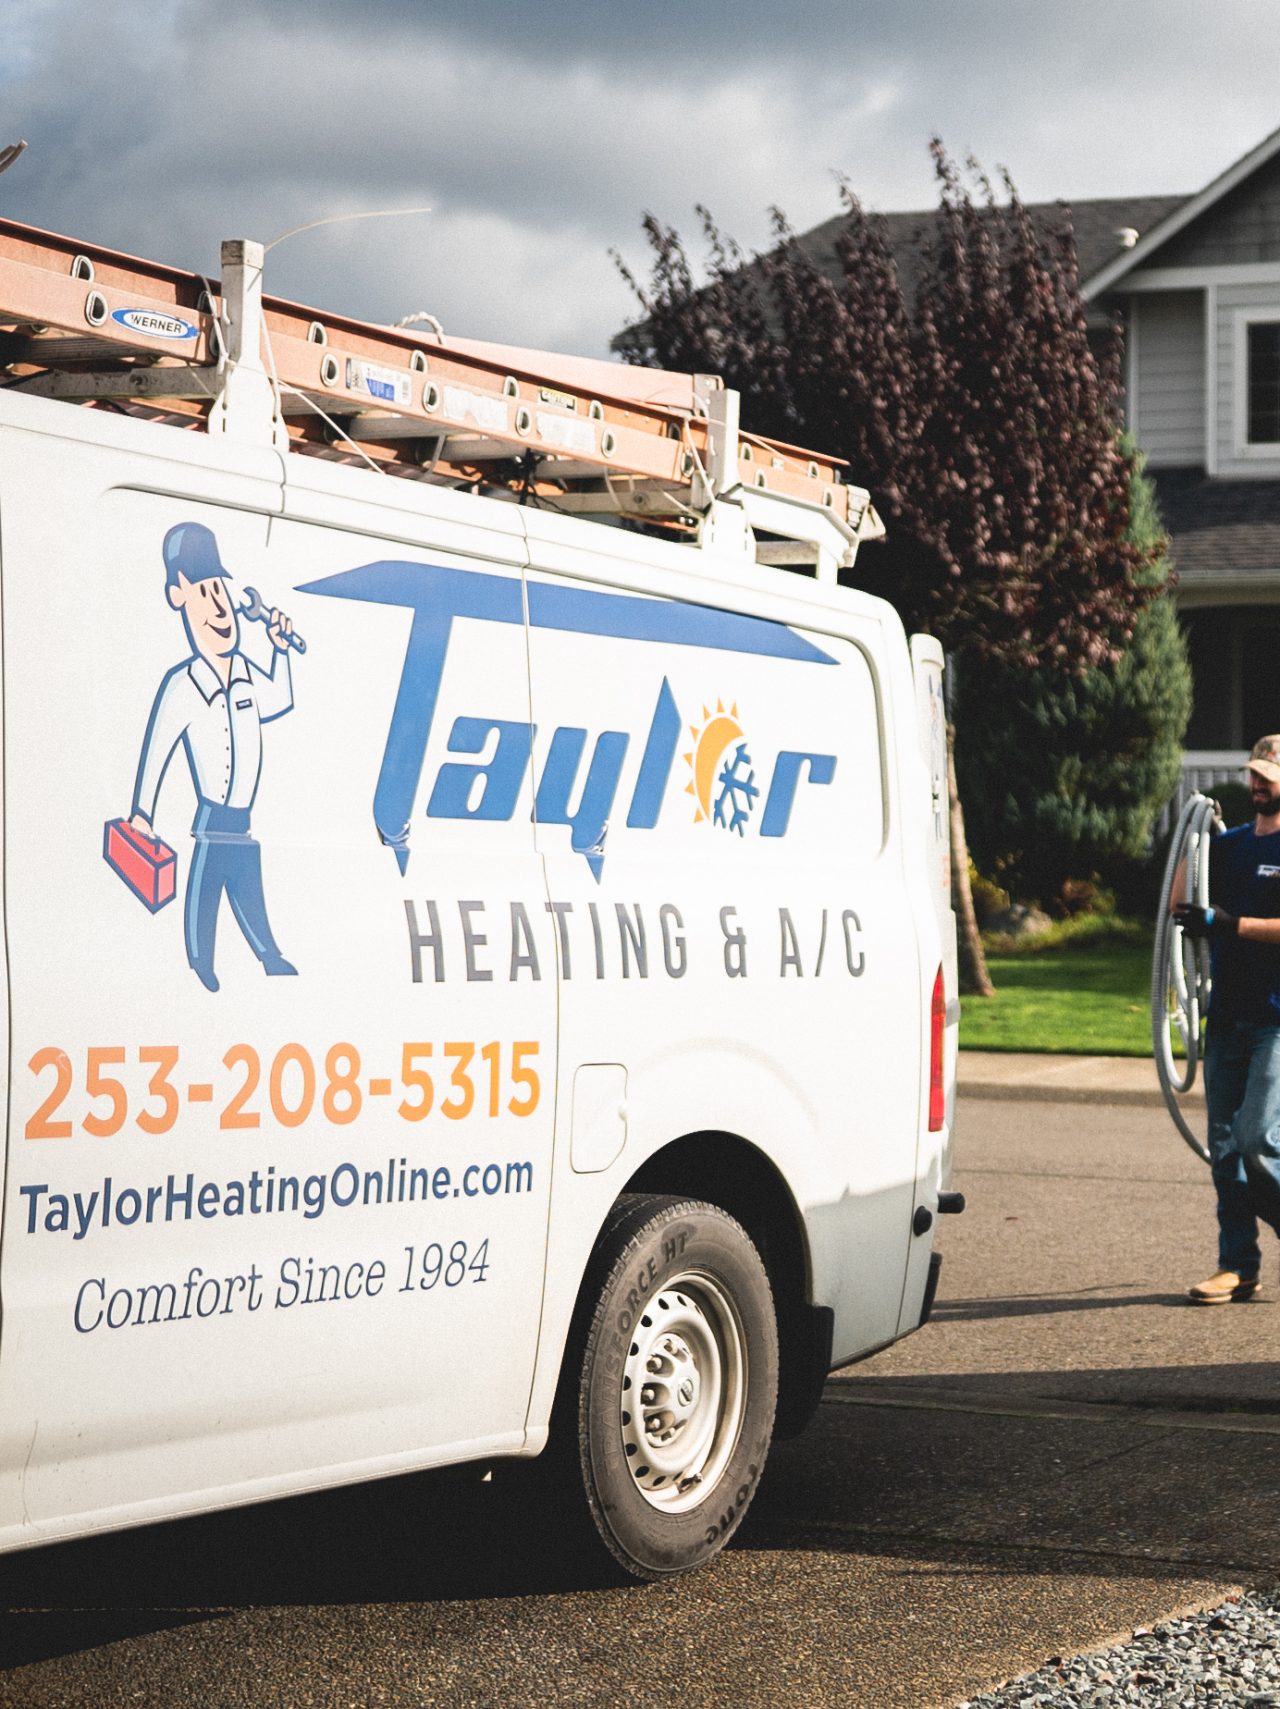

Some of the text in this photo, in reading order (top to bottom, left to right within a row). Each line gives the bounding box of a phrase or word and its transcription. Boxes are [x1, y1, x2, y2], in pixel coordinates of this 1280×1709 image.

[132, 314, 182, 333] WERNER
[292, 560, 841, 885] Taylor
[404, 899, 867, 984] HEATING & A/C
[25, 1040, 541, 1140] 253-208-5315
[19, 1158, 534, 1241] TaylorHeatingOnline.com
[72, 1237, 491, 1335] Comfort Since 1984
[664, 1230, 688, 1265] HT
